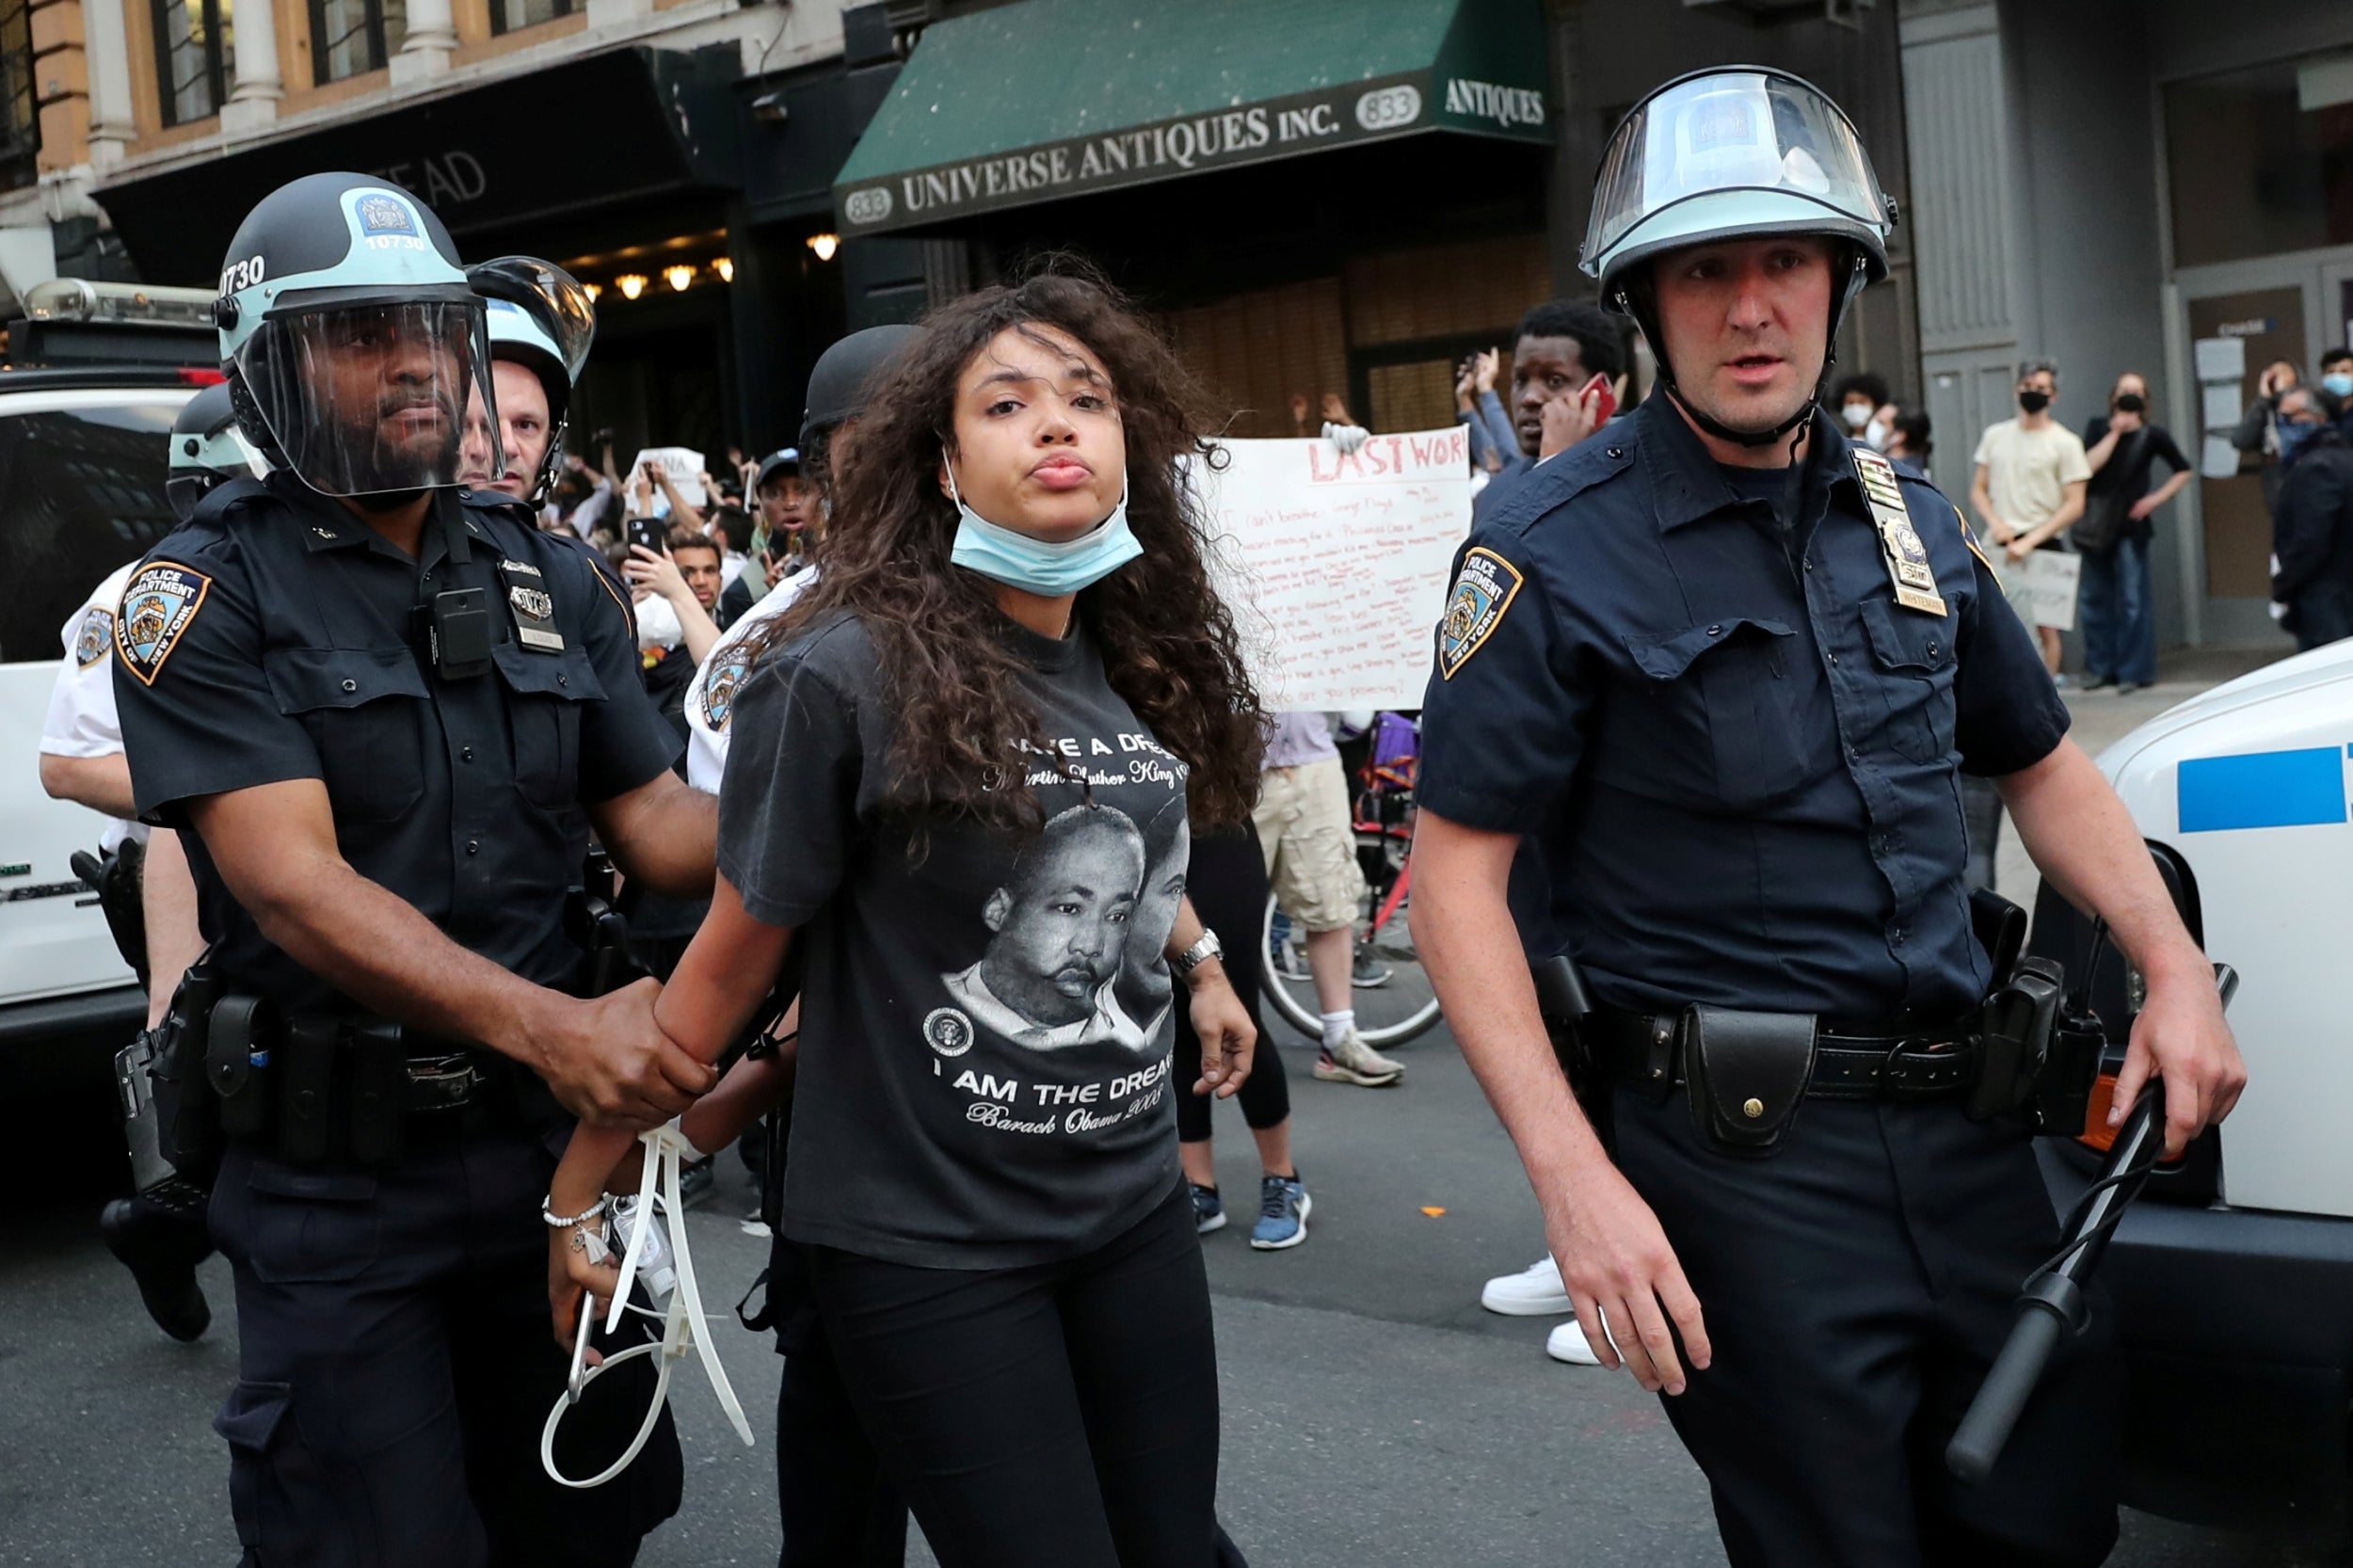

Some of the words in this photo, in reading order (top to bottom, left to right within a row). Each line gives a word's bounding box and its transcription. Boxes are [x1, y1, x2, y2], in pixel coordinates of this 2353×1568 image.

[1365, 91, 1412, 126] 833
[1444, 78, 1545, 128] ANTIQUES
[902, 147, 1071, 213] UNIVERSE
[1078, 106, 1270, 180] ANTIQUES
[1277, 104, 1341, 142] INC.
[850, 190, 887, 220] 833
[364, 234, 426, 252] 10730
[1308, 436, 1402, 483] LAST
[138, 568, 184, 584] POLICE
[1467, 555, 1498, 580] POLICE
[123, 580, 197, 603] DEPARTMENT
[118, 618, 130, 647] CITY
[125, 647, 139, 664] OF
[150, 637, 170, 666] NEW
[165, 604, 193, 638] YORK
[1469, 609, 1497, 643] YORK
[1090, 737, 1113, 757] A
[1128, 759, 1176, 791] King
[933, 1056, 942, 1078] I
[952, 1068, 1019, 1104] AM
[1032, 1081, 1102, 1107] THE
[965, 1100, 1058, 1136] Barack
[1064, 1106, 1124, 1135] Obama
[1123, 1082, 1165, 1122] 2008
